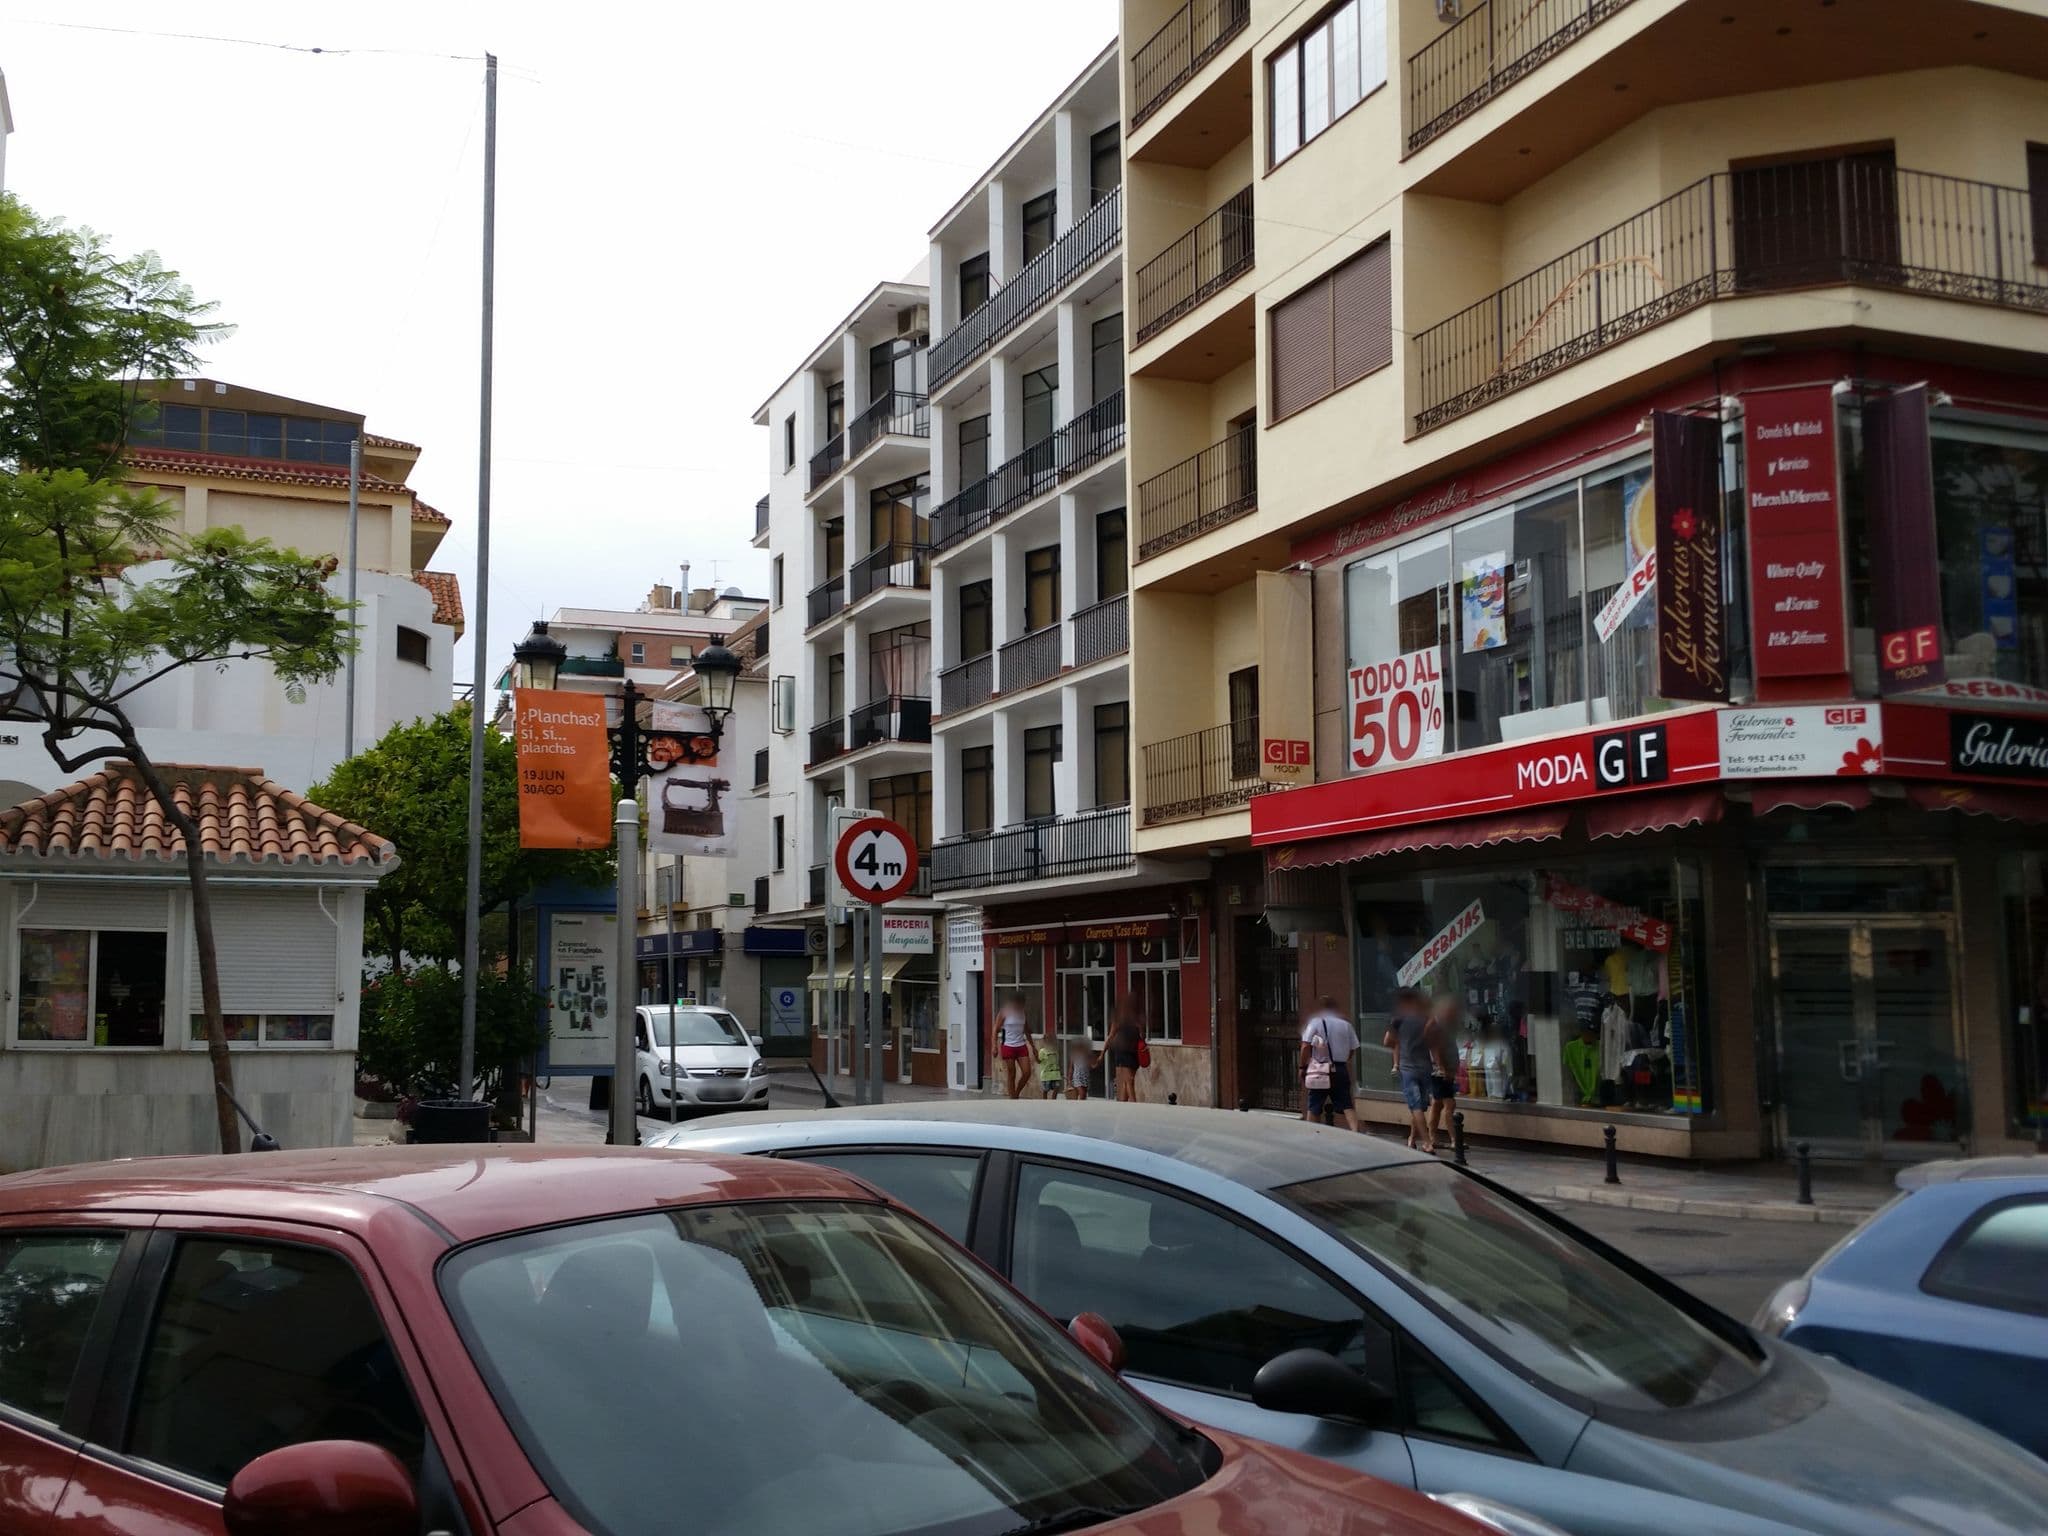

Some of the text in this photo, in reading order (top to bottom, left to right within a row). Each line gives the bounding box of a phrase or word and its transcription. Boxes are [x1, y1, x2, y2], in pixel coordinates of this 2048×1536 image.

[1886, 630, 1932, 664] GF
[1350, 651, 1440, 699] TODO AL
[520, 708, 600, 727] ¿Planchas?
[1352, 684, 1442, 768] 50%
[1828, 709, 1863, 724] GF
[521, 742, 576, 755] planchas
[1268, 743, 1305, 761] GF
[1748, 754, 1765, 763] 952
[1517, 752, 1589, 791] MODA
[1423, 903, 1481, 969] REBAJAS
